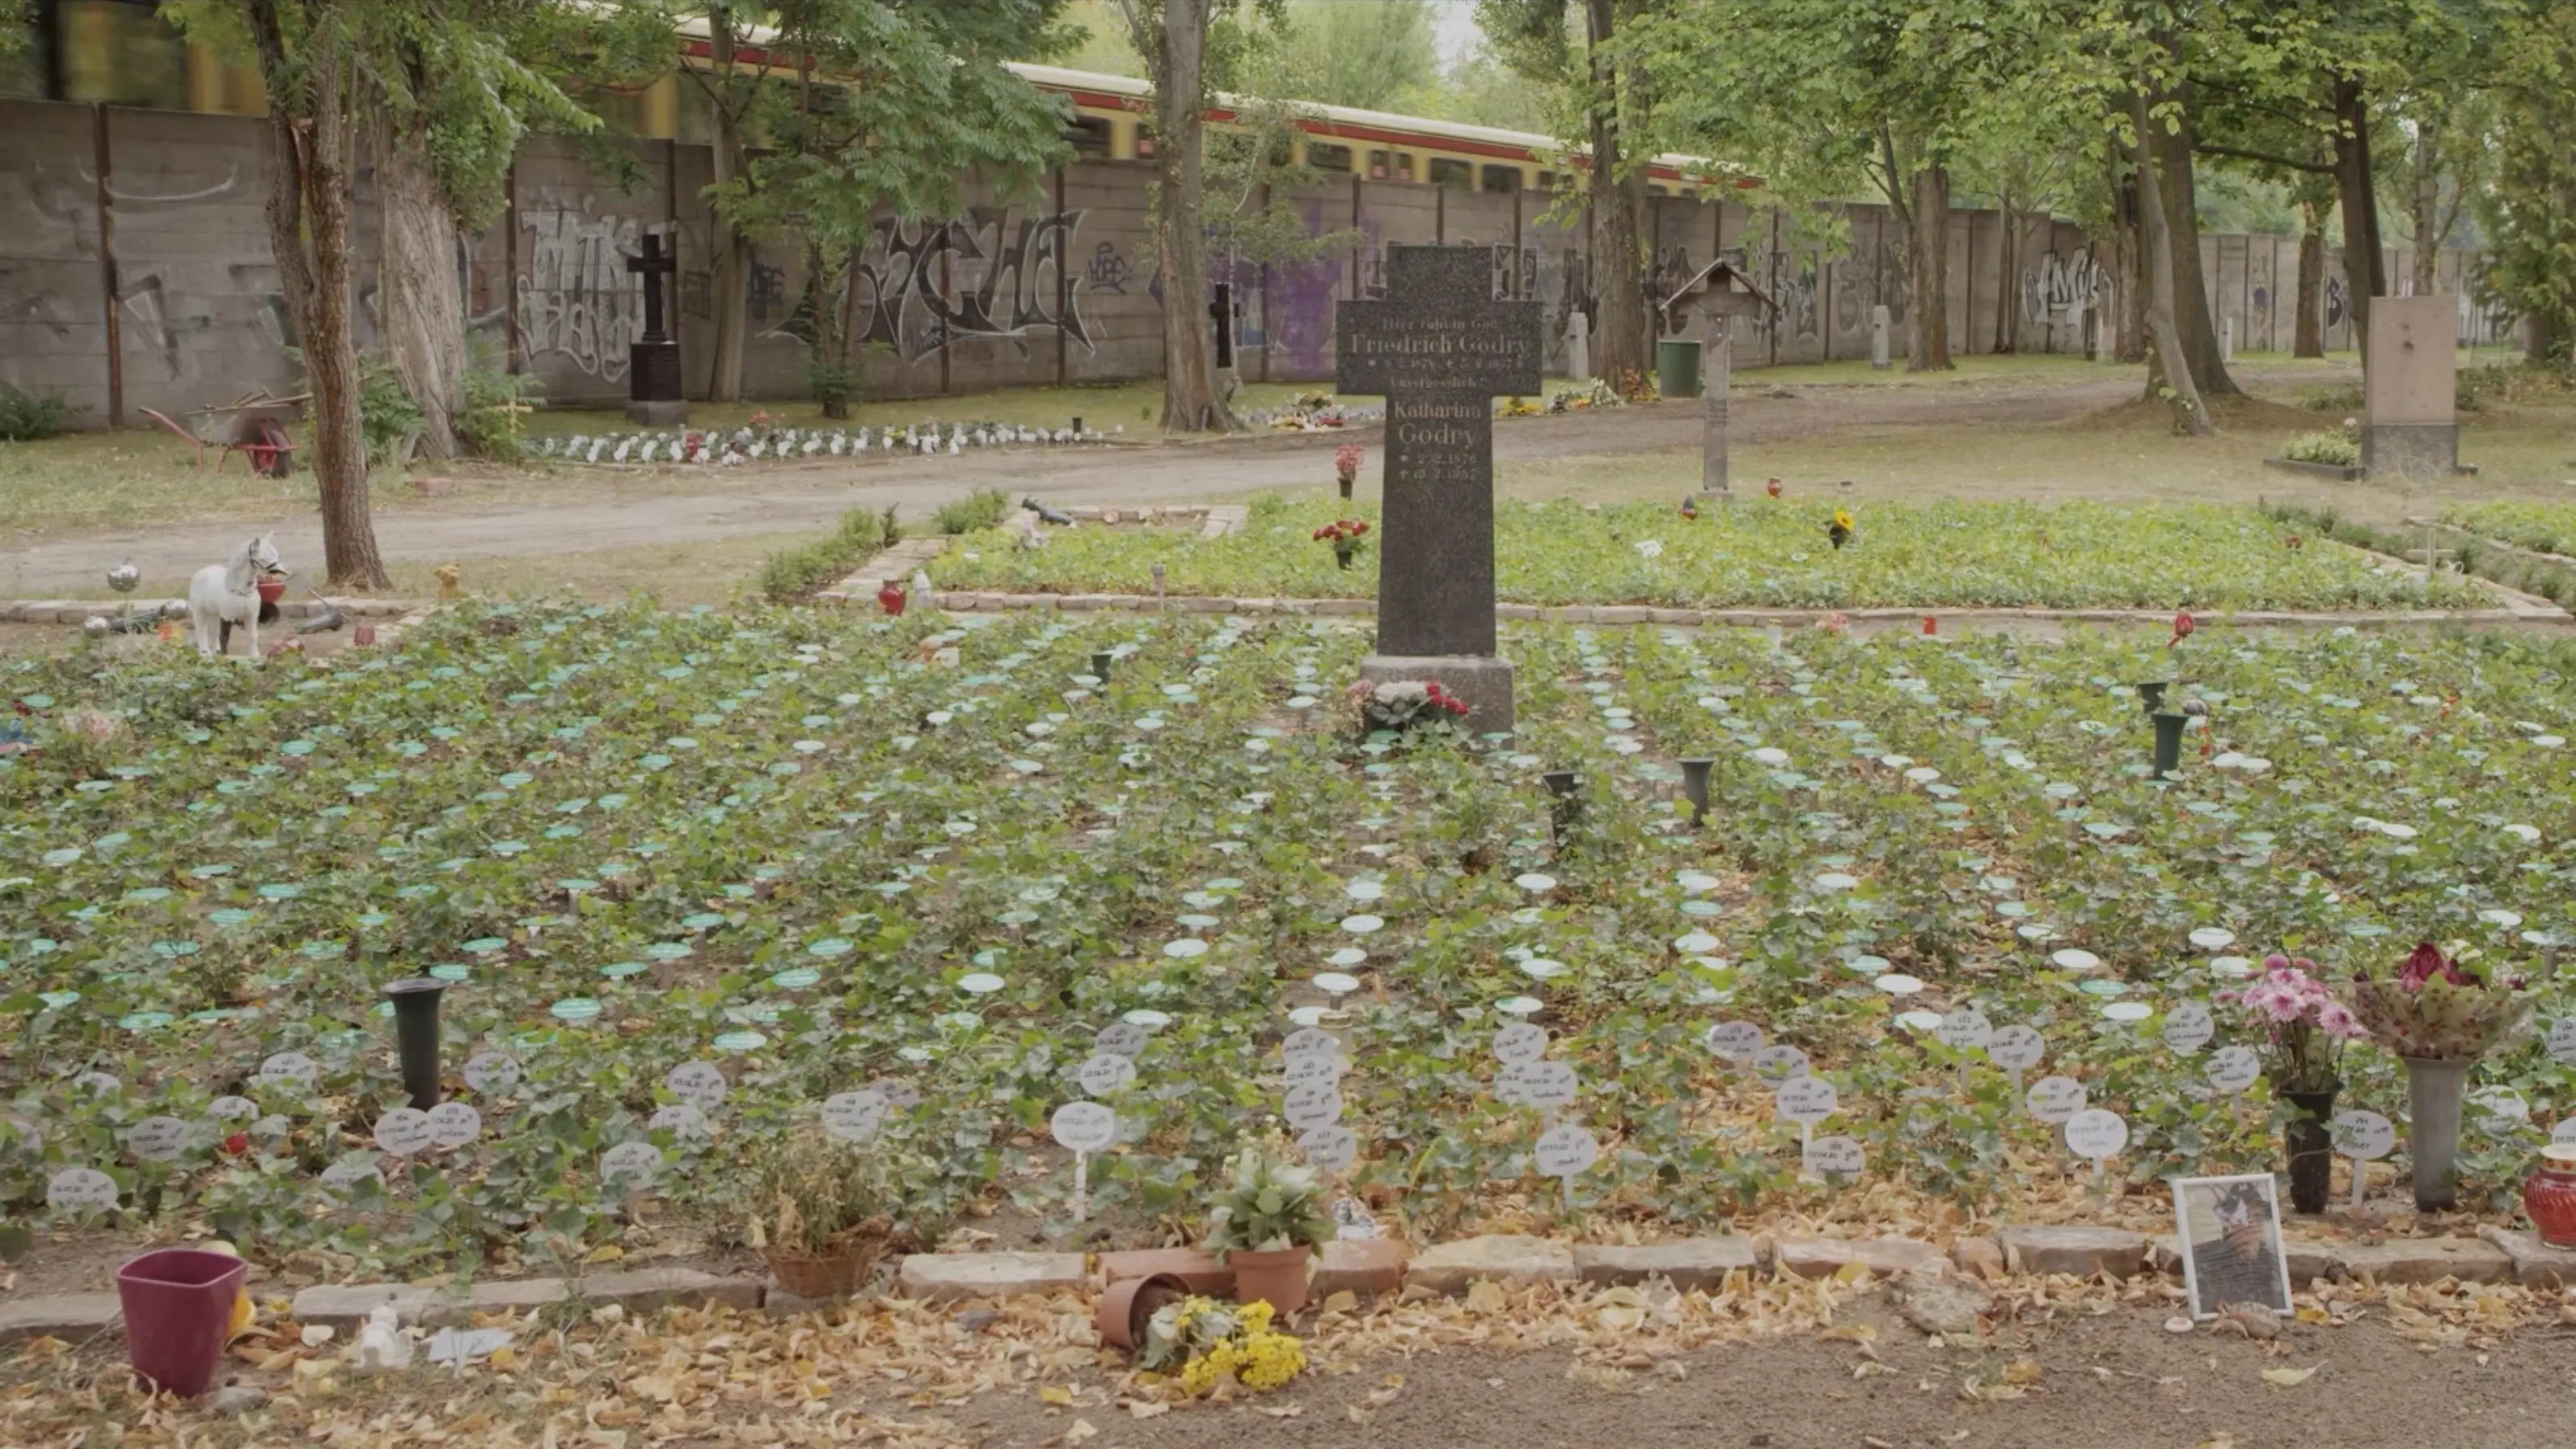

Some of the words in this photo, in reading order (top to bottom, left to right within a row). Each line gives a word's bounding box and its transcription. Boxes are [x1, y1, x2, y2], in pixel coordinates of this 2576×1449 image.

[1350, 333, 1453, 353] Friedrich
[1459, 333, 1529, 357] Godry
[1393, 400, 1483, 419] Katharina
[1398, 422, 1476, 447] Godry
